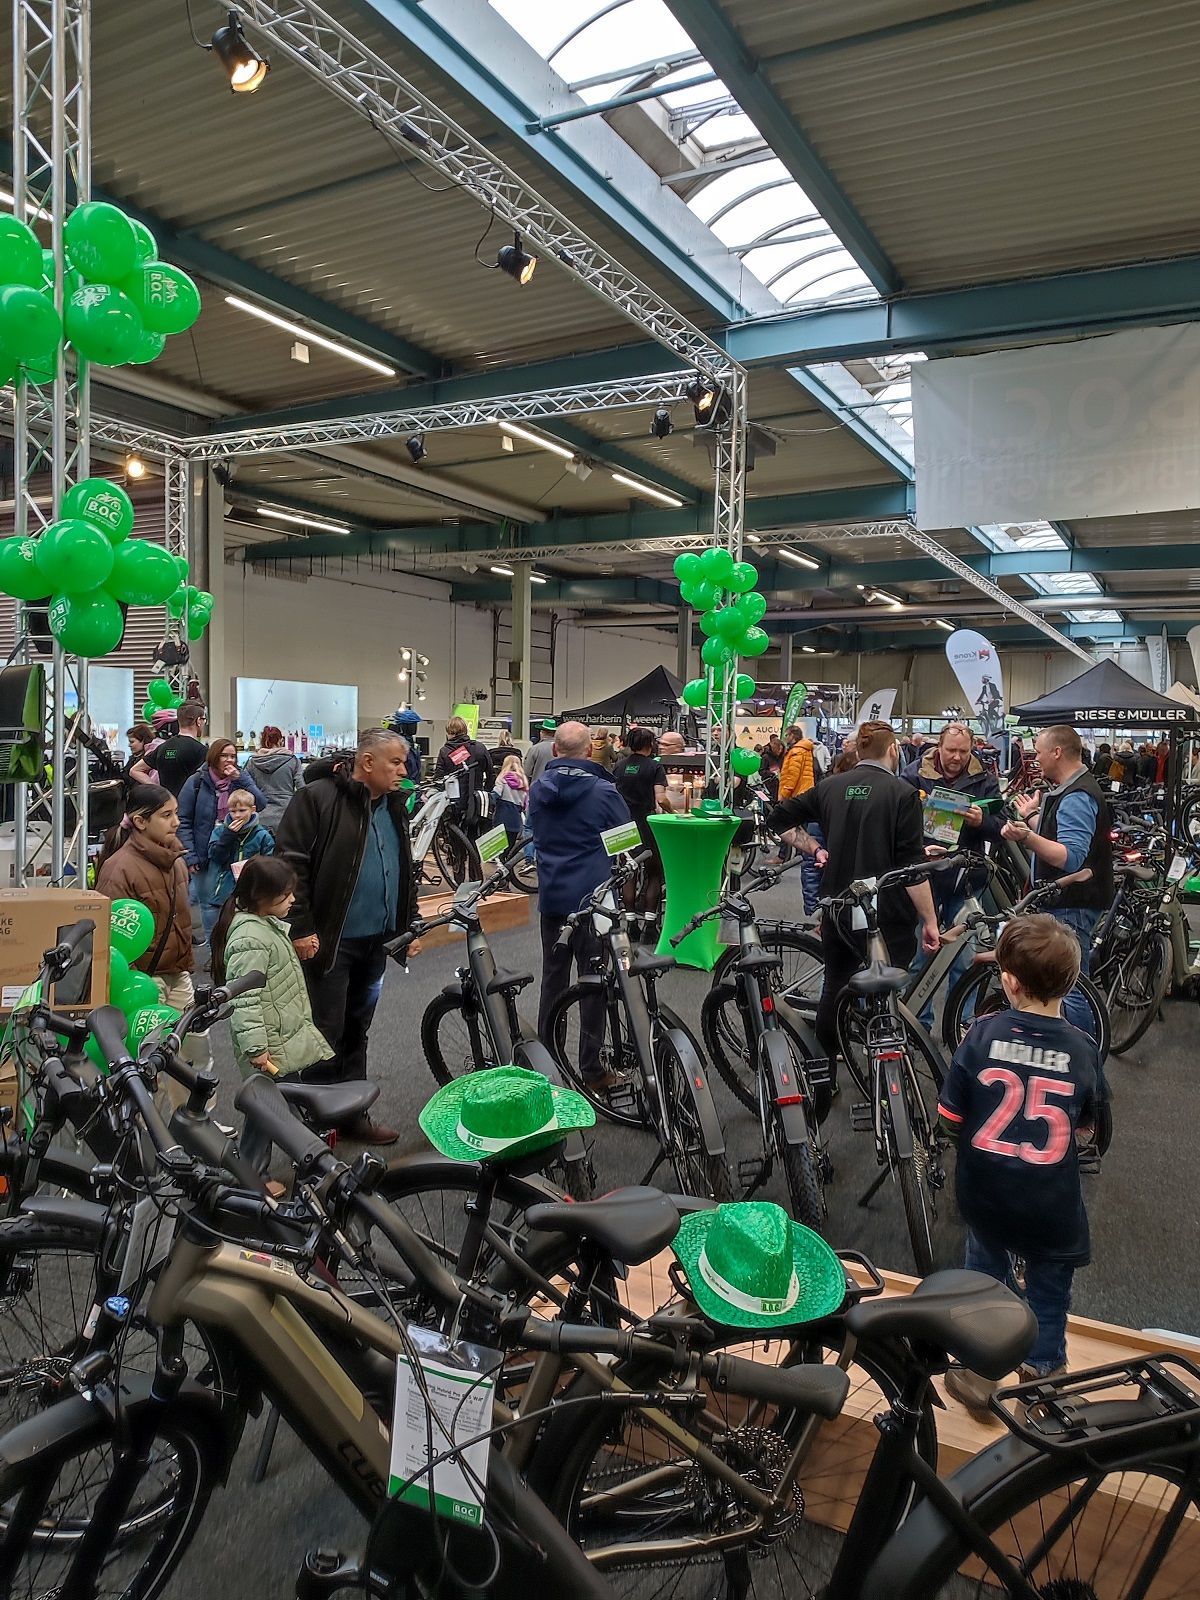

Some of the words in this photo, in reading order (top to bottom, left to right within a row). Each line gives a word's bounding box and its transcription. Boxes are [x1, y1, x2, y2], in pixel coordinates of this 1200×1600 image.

[88, 501, 119, 524] B.O.C.
[755, 726, 782, 734] AUGU
[0, 918, 13, 926] KE
[0, 927, 11, 935] AG
[110, 915, 135, 933] B.O.C.
[971, 1067, 1076, 1165] 25
[337, 1441, 388, 1499] CUB
